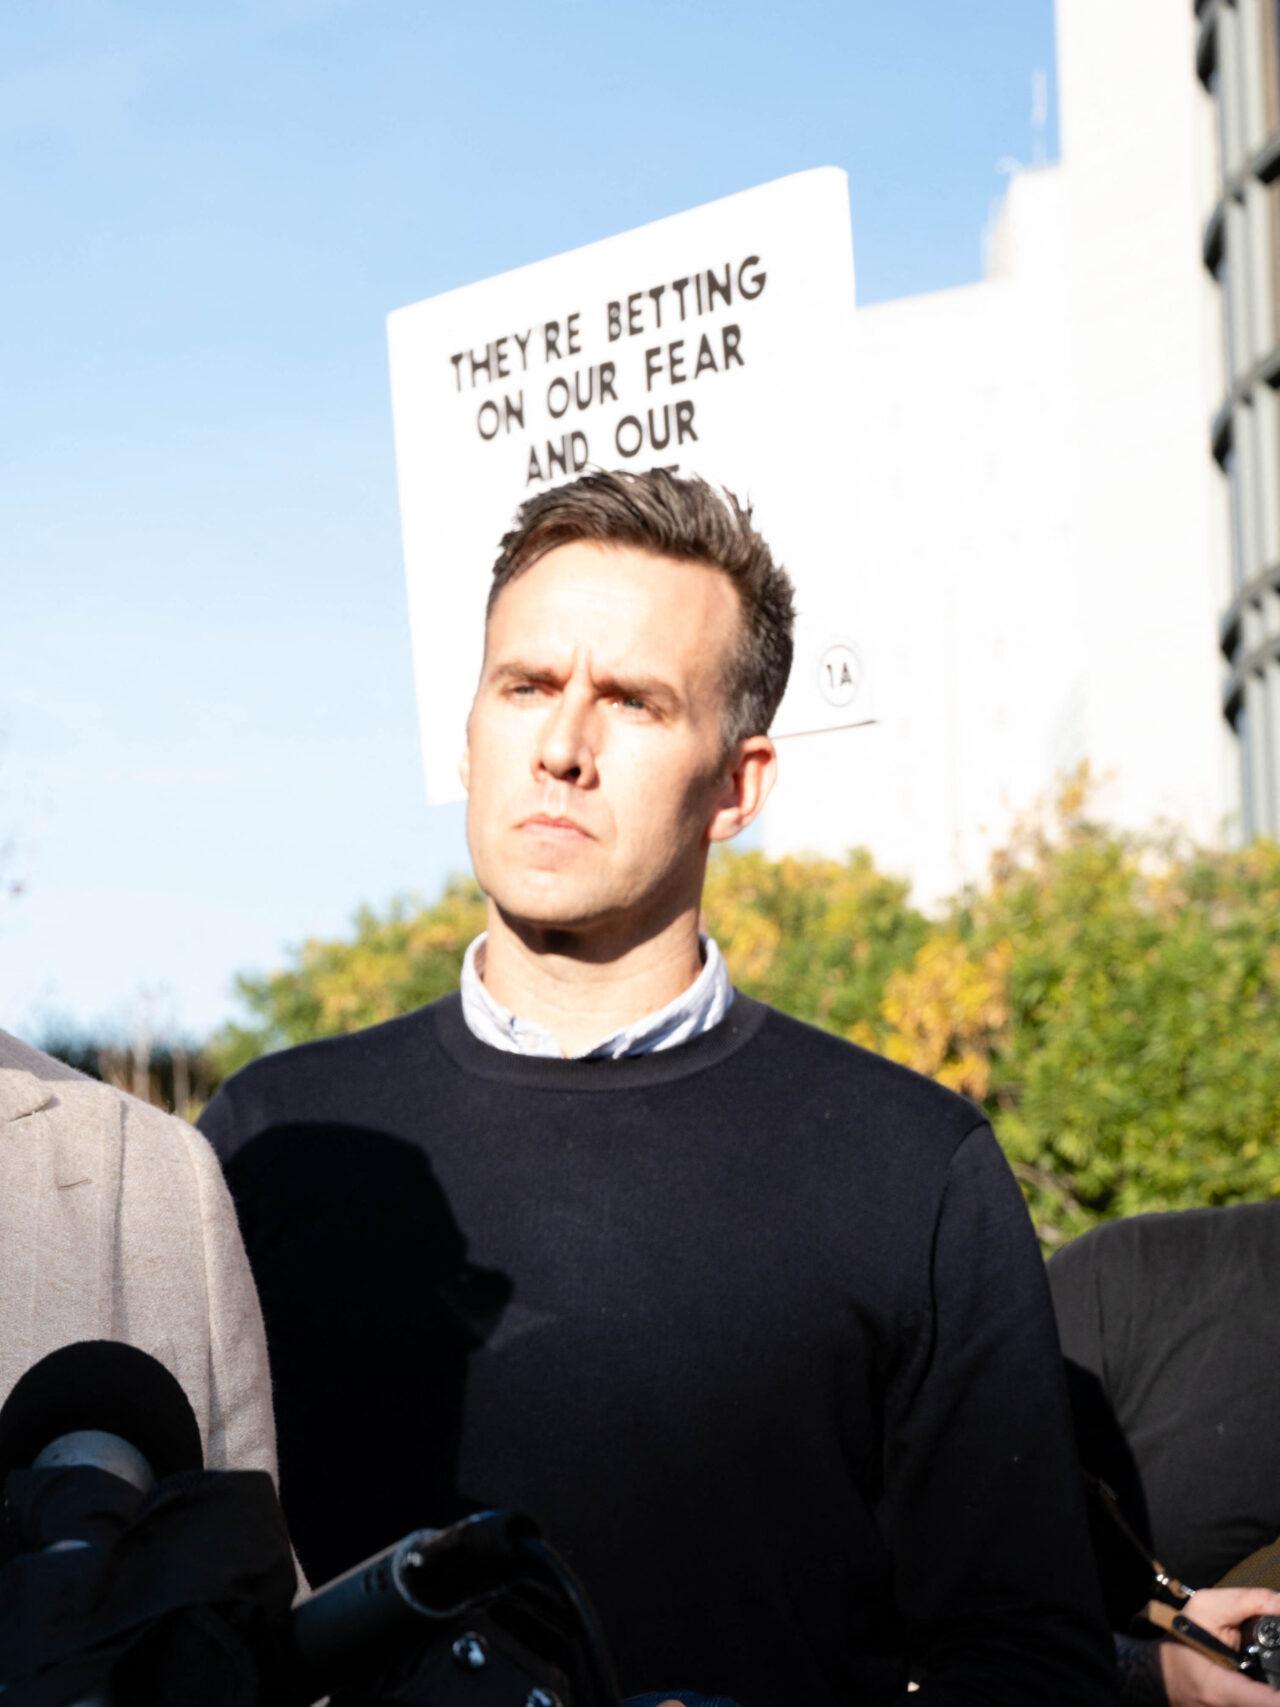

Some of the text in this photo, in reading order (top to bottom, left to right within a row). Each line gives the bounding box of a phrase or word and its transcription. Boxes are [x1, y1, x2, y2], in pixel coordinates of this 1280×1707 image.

[450, 255, 767, 392] THEYRE BETTING
[476, 324, 745, 441] ON OUR FEAR
[525, 400, 699, 487] AND OUR
